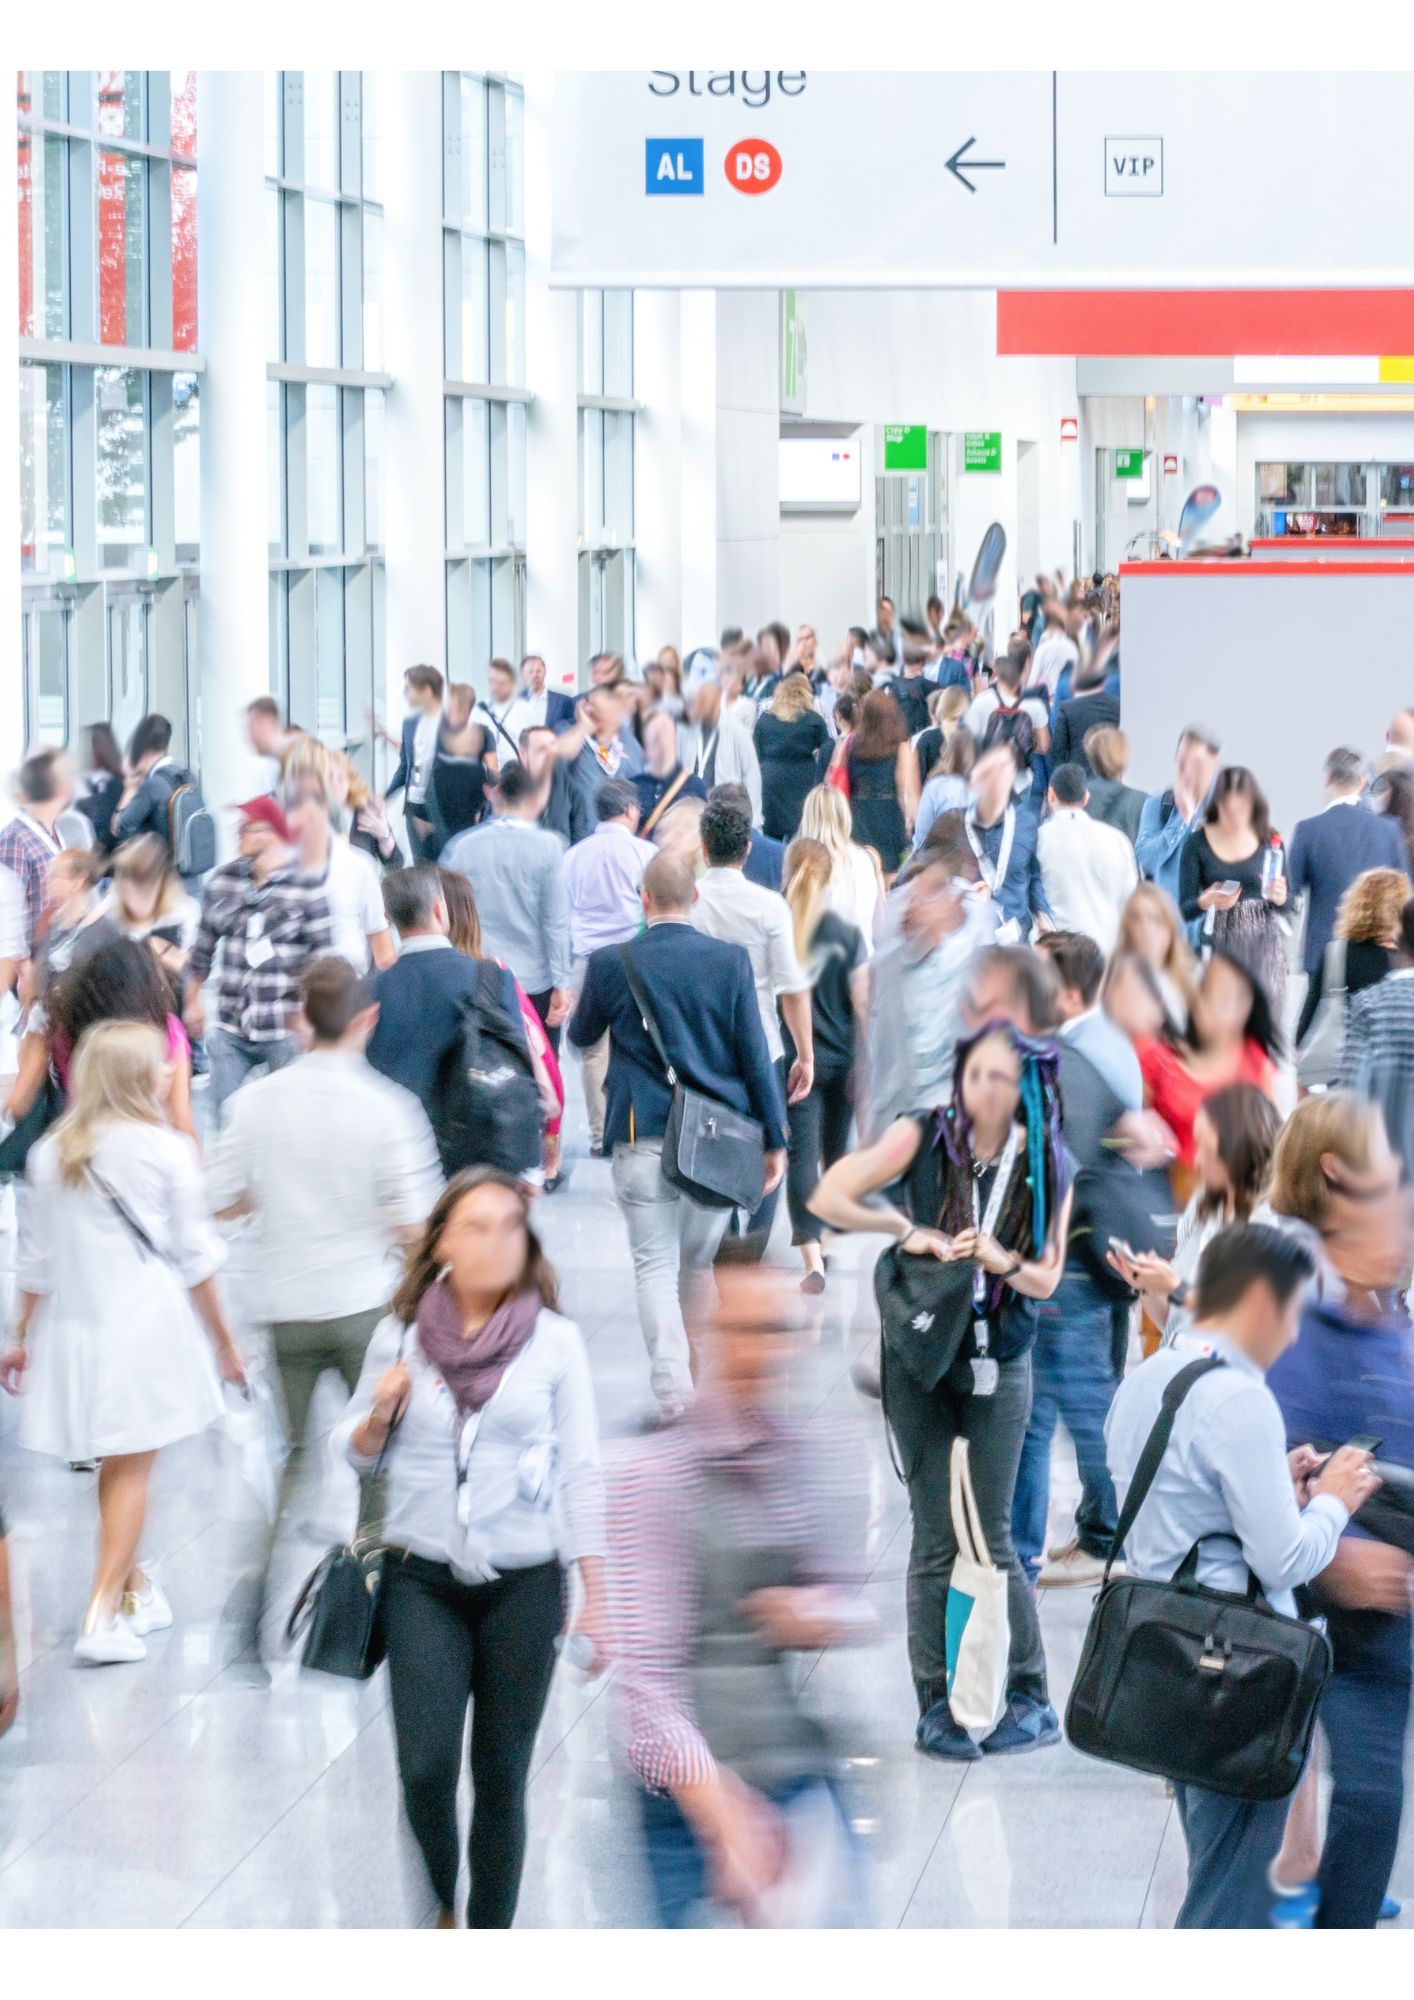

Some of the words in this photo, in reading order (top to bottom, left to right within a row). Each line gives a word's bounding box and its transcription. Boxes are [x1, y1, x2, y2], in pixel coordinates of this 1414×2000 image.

[648, 71, 807, 108] Stage
[656, 152, 694, 181] AL
[736, 152, 771, 181] DS
[1113, 157, 1155, 176] VIP
